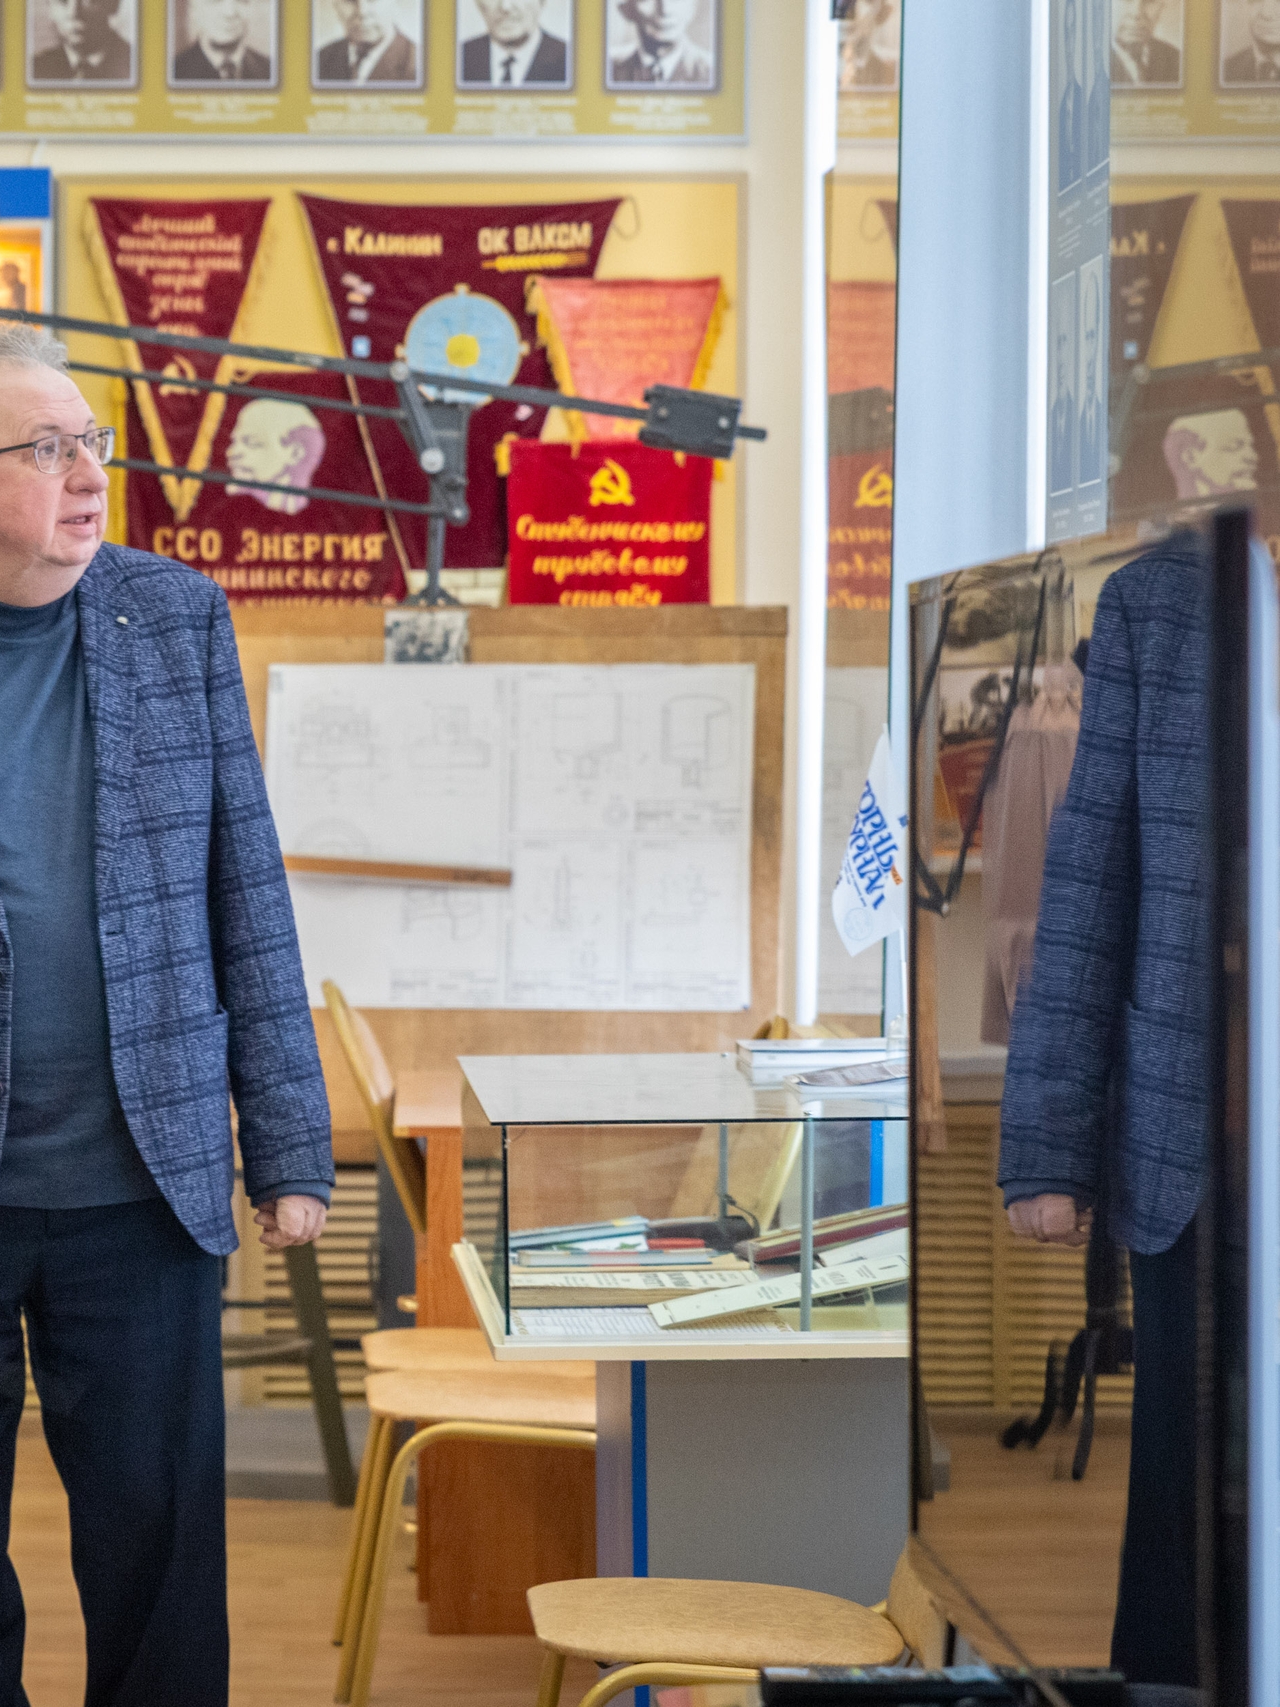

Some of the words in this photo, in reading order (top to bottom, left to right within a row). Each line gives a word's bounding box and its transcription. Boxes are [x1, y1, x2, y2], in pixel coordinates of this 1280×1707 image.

[477, 226, 511, 255] ОК
[514, 220, 592, 252] ВЛКСМ
[152, 526, 222, 562] ССО
